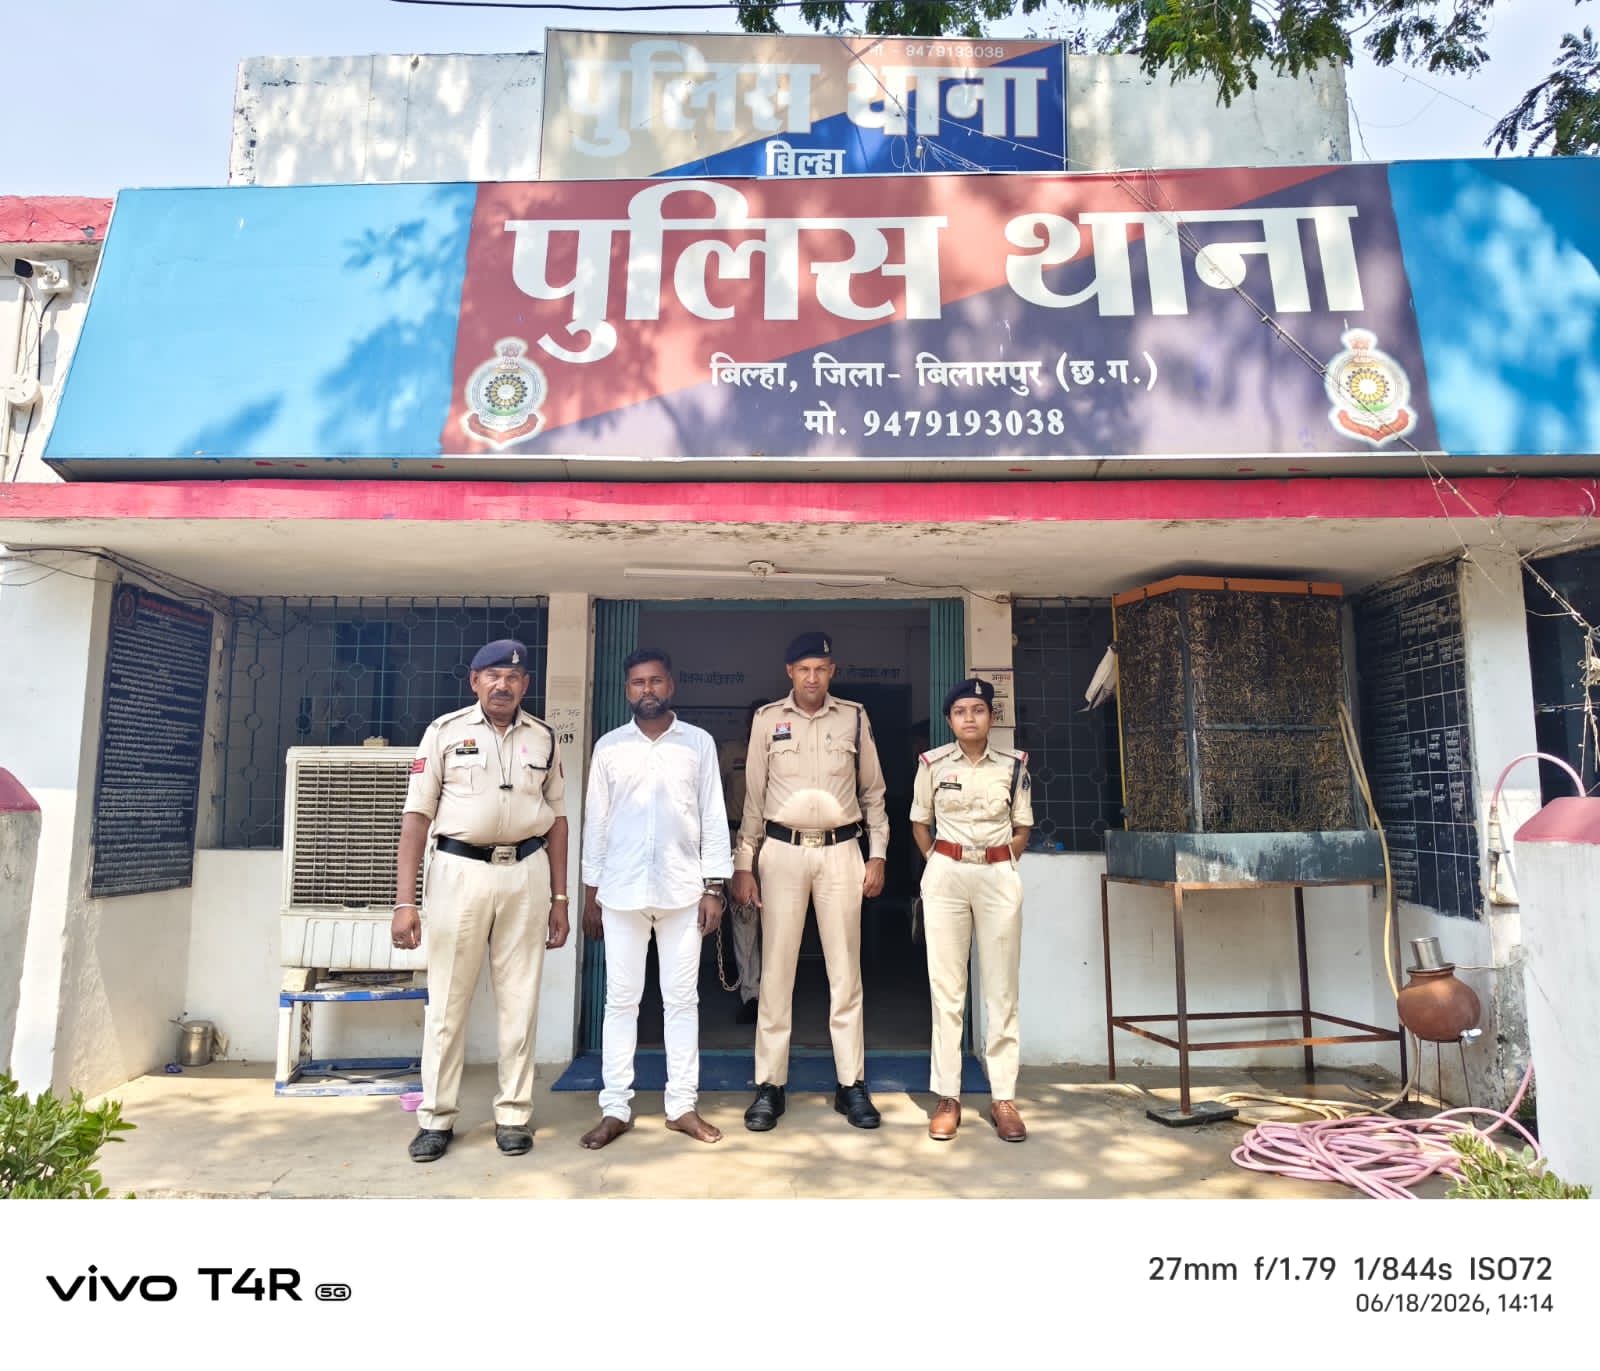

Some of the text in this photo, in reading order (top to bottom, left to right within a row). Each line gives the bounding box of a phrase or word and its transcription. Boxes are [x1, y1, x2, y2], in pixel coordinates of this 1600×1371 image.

[565, 39, 1048, 158] पुलिस थाना
[765, 140, 847, 176] बिल्हा
[503, 180, 1365, 363] पुलिस थाना
[709, 351, 1159, 396] बिल्हा, जिला- बिलासपुर (छ.ग.)
[803, 400, 1065, 437] मो. 9479193038
